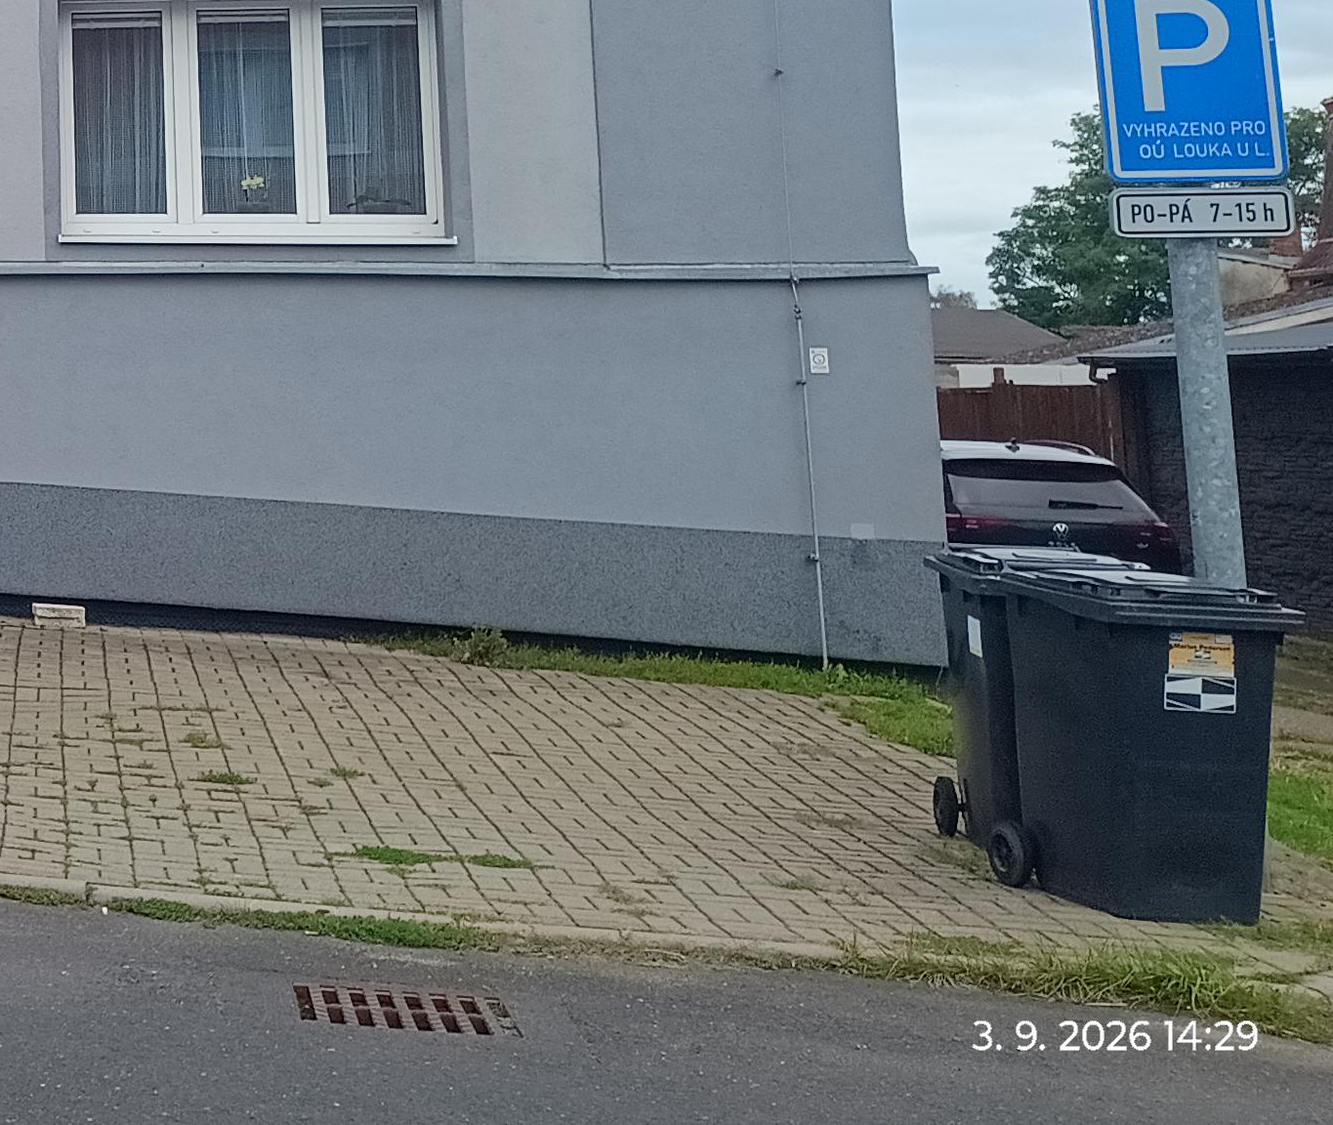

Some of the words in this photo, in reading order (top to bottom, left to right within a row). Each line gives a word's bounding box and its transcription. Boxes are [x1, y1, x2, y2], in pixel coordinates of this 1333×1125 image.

[1122, 121, 1226, 138] VYHRAZENO
[1230, 120, 1267, 136] PRO
[1139, 140, 1165, 159] OÚ
[1173, 142, 1233, 159] LOUKA
[1237, 142, 1250, 157] U
[1254, 142, 1270, 157] L.
[1130, 198, 1194, 224] PO-PÁ
[1209, 202, 1257, 223] 7-15
[1263, 202, 1275, 223] h
